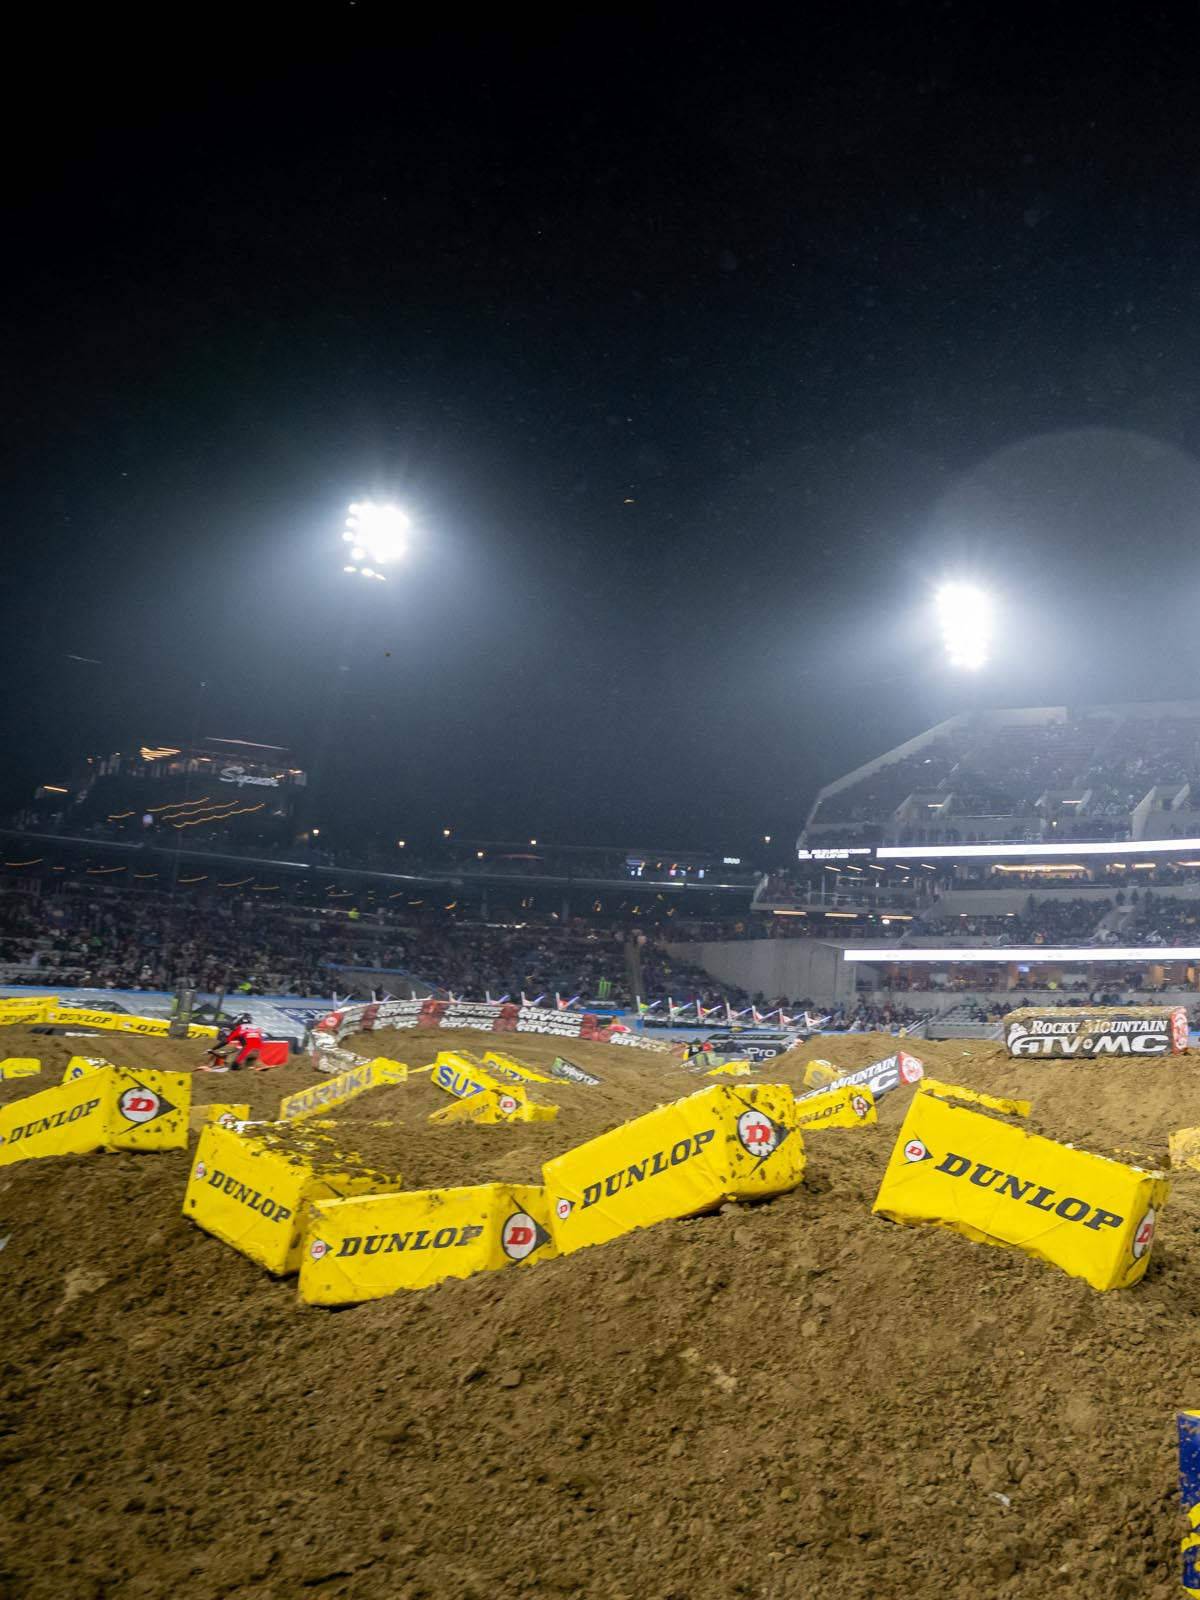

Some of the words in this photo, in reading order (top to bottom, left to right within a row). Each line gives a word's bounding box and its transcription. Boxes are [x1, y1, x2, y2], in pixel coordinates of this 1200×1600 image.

[58, 1013, 112, 1024] DUNLOP
[1030, 1019, 1080, 1034] ROCKY
[742, 1047, 777, 1058] Pro
[286, 1067, 371, 1117] SUZUKI
[830, 1055, 898, 1092] MOUNTAIN
[7, 1098, 101, 1144] DUNLOP
[580, 1129, 716, 1210] DUNLOP
[208, 1170, 291, 1224] DUNLOP
[935, 1152, 1124, 1231] DUNLOP
[335, 1225, 485, 1257] DUNLOP
